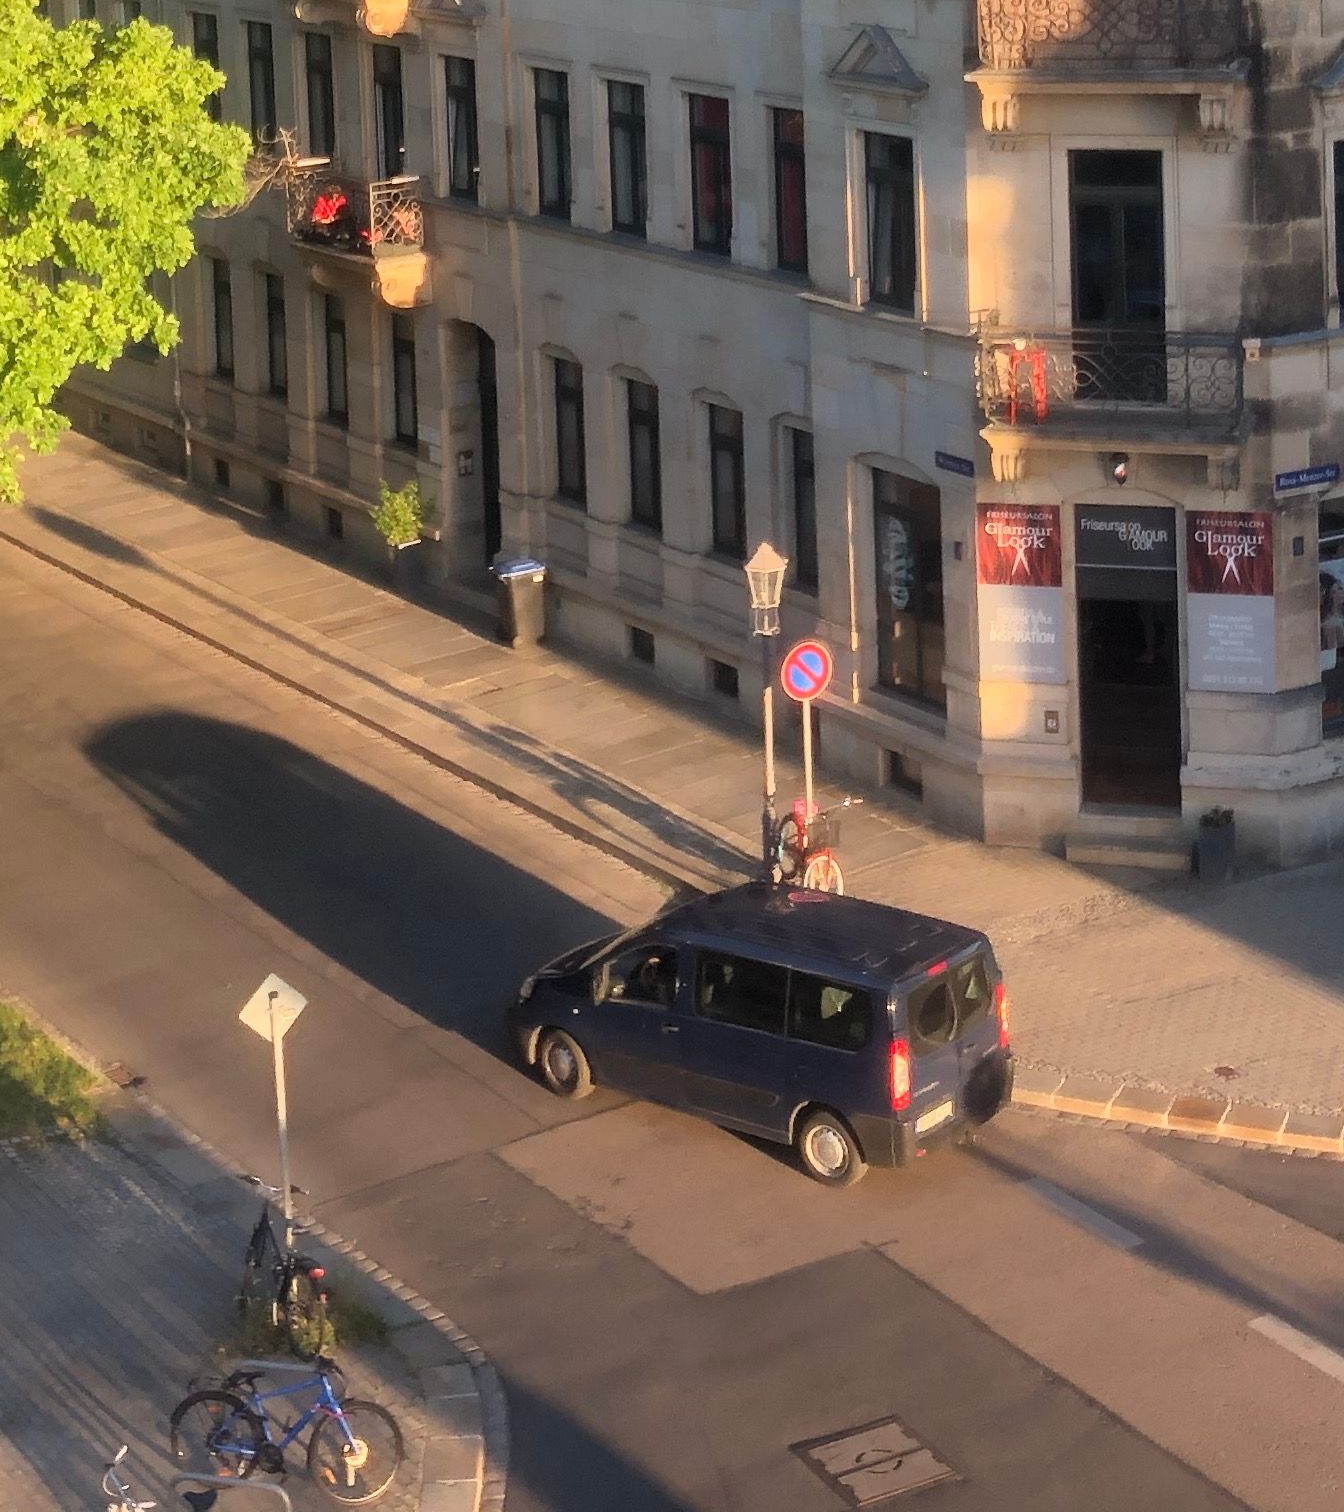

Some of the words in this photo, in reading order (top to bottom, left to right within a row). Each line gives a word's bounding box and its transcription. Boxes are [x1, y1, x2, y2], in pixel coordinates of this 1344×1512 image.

[984, 522, 1053, 537] Glamour
[1196, 519, 1265, 529] FRISEURSALON
[996, 534, 1046, 549] Look
[1194, 530, 1265, 545] Glamour
[1207, 542, 1257, 557] Look
